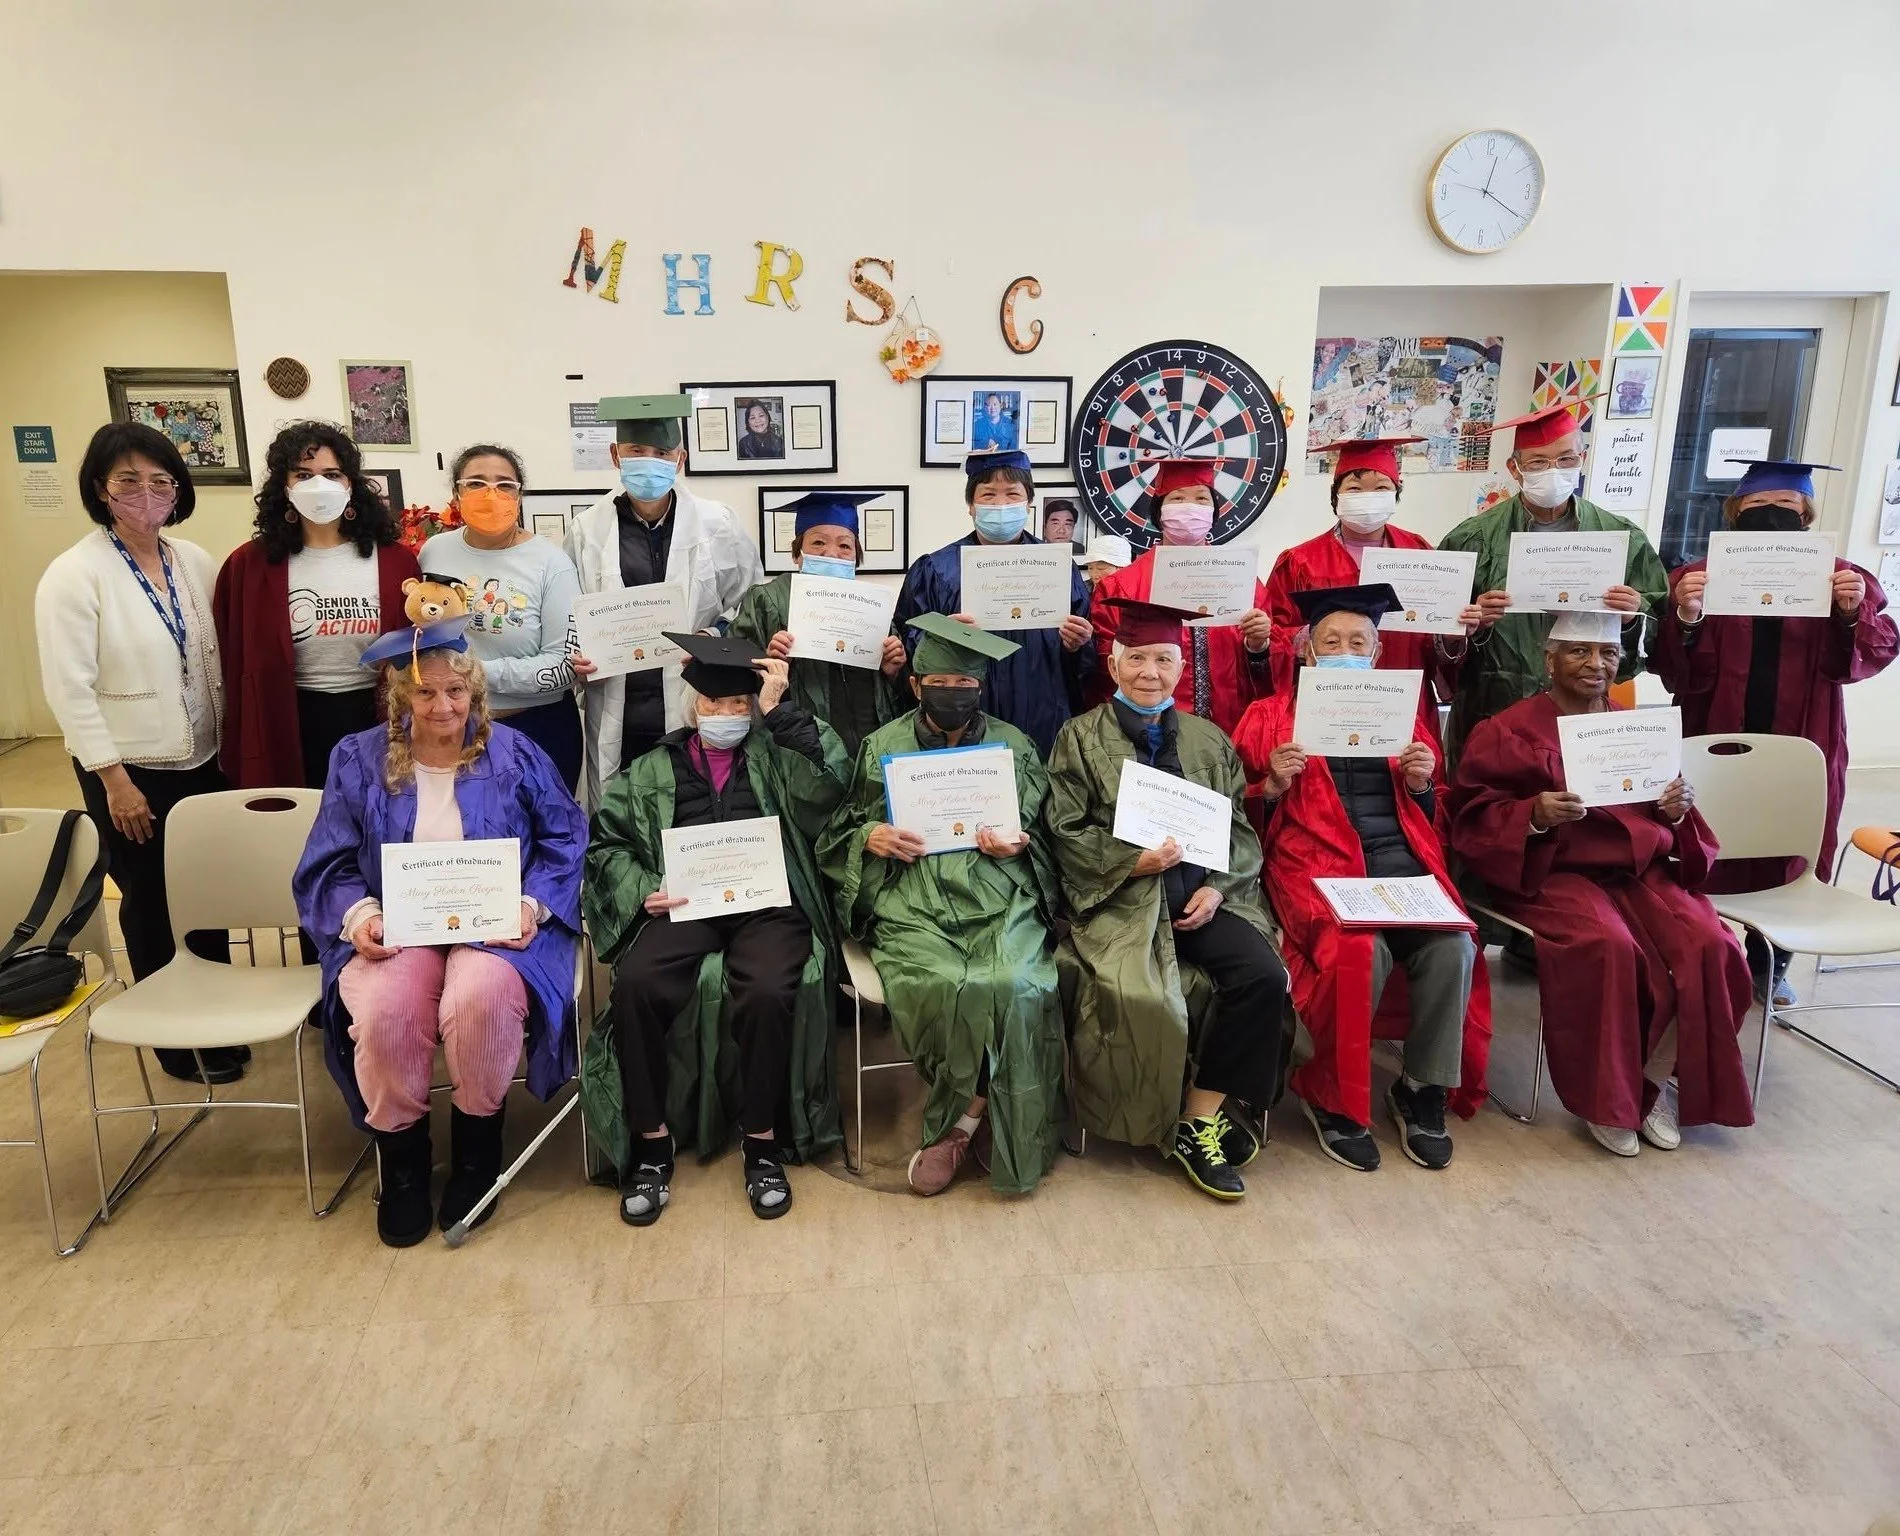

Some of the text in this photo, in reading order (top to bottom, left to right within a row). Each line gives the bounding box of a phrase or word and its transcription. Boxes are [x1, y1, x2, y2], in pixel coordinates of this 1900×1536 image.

[1487, 138, 1495, 156] 12
[1441, 184, 1447, 200] 9
[1524, 184, 1530, 200] 3
[1478, 228, 1483, 245] 6
[563, 227, 1044, 354] M H R S C
[1167, 349, 1182, 361] 14
[1197, 351, 1206, 363] 9
[1134, 354, 1151, 370] 11
[1221, 362, 1239, 378] 12
[1113, 374, 1124, 386] 8
[1244, 383, 1253, 394] 5
[1091, 395, 1108, 412] 16
[1256, 405, 1272, 424] 20
[1082, 425, 1094, 436] 7
[1612, 432, 1644, 448] patient
[1079, 451, 1092, 468] 19
[1259, 467, 1274, 482] 18
[1609, 466, 1642, 477] humble
[1088, 486, 1100, 497] 3
[1604, 483, 1633, 496] loving
[1248, 496, 1258, 505] 4
[1098, 506, 1115, 523] 17
[1225, 515, 1242, 530] 13
[1123, 527, 1133, 539] 2
[1526, 546, 1561, 554] Certificate
[1573, 545, 1612, 553] Graduation
[1726, 544, 1764, 553] Certificate
[1776, 544, 1818, 554] Graduation
[977, 560, 1009, 568] Certificate
[1169, 560, 1201, 568] Certificate
[1377, 561, 1411, 569] Certificate
[1421, 563, 1459, 573] Graduation
[316, 598, 369, 608] SENIOR &
[849, 594, 881, 607] Graduation
[316, 608, 379, 620] DISABILITY
[590, 604, 623, 616] Certificate
[633, 599, 671, 607] Graduation
[316, 620, 378, 635] ACTION
[1316, 683, 1353, 691] Certificate
[1364, 684, 1404, 693] Graduation
[1577, 728, 1615, 739] Certificate
[1626, 724, 1666, 732] Graduation
[911, 768, 998, 781] Certificate of Graduation
[1137, 780, 1170, 793] Certificate
[1180, 791, 1216, 812] Graduation
[680, 841, 715, 852] Certificate
[726, 836, 765, 844] Graduation
[402, 857, 501, 870] Certificate of Graduation
